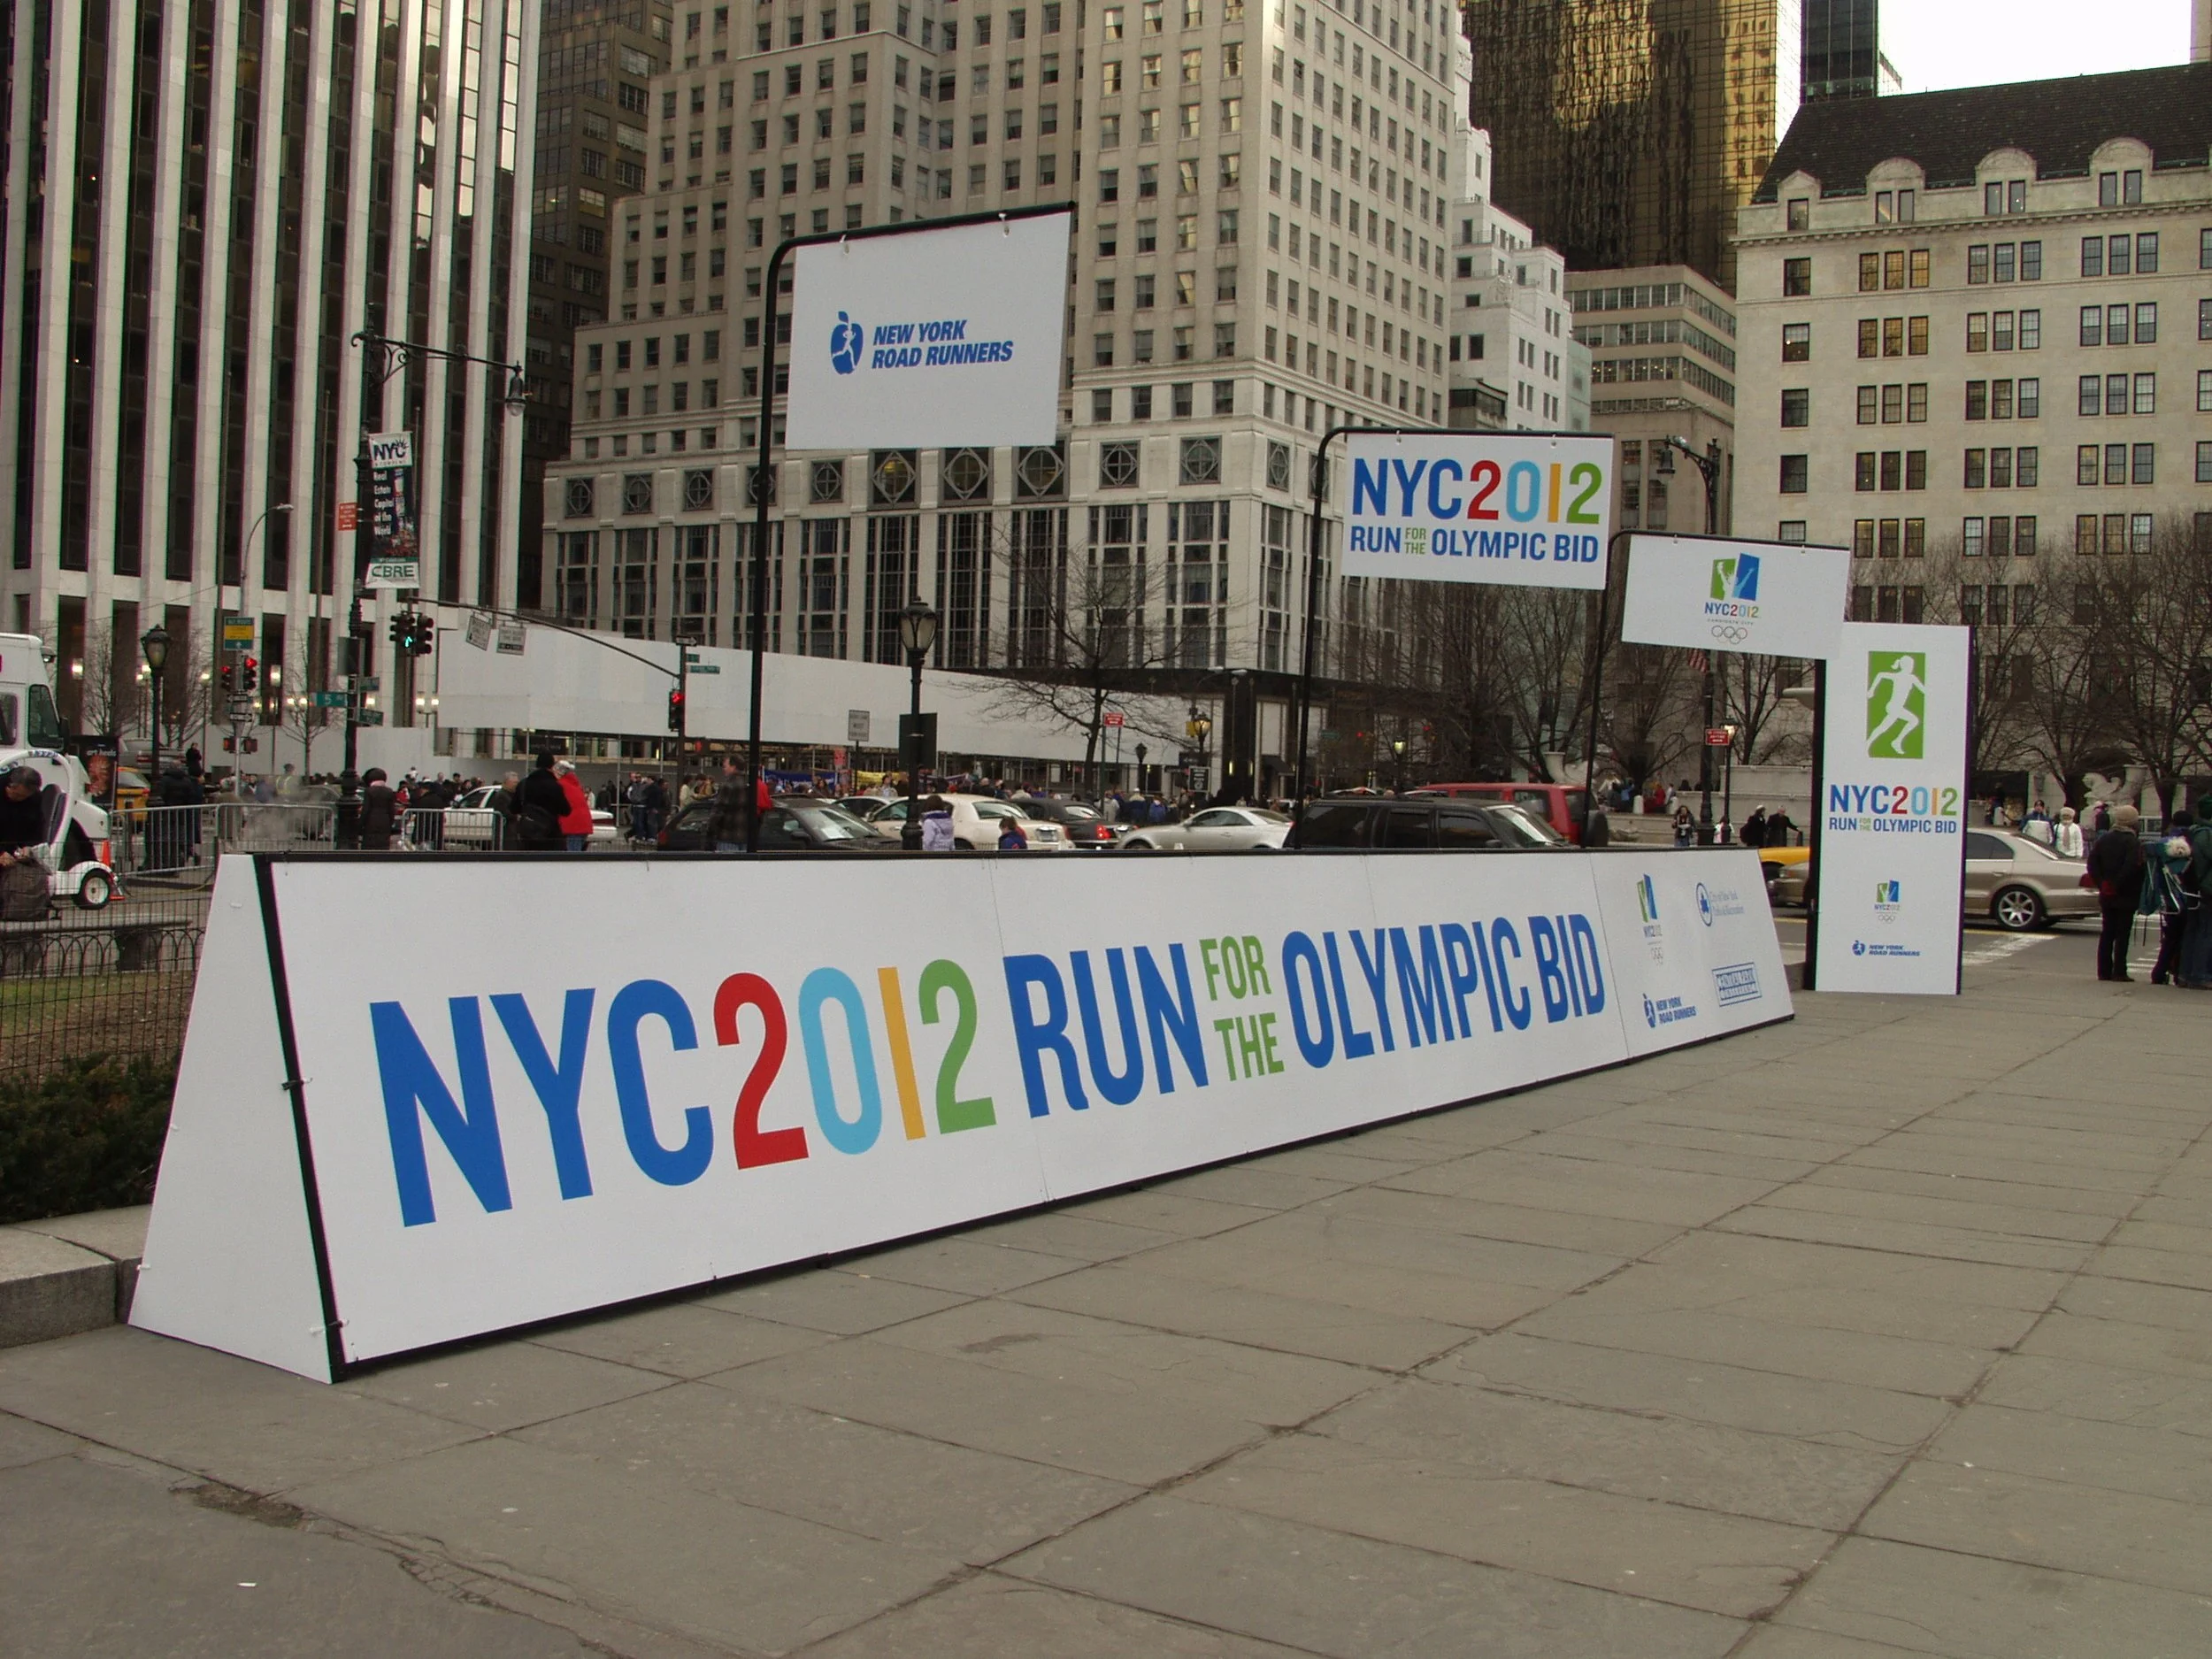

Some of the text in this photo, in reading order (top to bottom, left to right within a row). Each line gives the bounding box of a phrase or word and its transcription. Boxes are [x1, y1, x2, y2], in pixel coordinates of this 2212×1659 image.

[872, 319, 967, 346] NEW YORK
[872, 341, 1014, 369] ROAD RUNNERS
[373, 440, 409, 460] NYC
[1352, 458, 1602, 525] NYC2012
[1350, 526, 1599, 563] RUN FOR OLYMPIC BID
[1404, 541, 1426, 555] THE
[372, 565, 415, 578] CBRE
[1704, 602, 1760, 618] NYC2012
[325, 694, 332, 705] 5
[1830, 784, 1958, 817] NYC2012
[1829, 818, 1857, 831] RUN
[1873, 818, 1932, 833] OLYMPIC
[1935, 820, 1956, 833] BID
[1656, 996, 1682, 1010] NEW YORK
[1002, 914, 1606, 1118] RUN FOR OLYMPIC BID
[1659, 1006, 1696, 1024] ROAD RUNNERS
[1214, 1012, 1285, 1081] THE
[369, 959, 996, 1228] NYC2012
